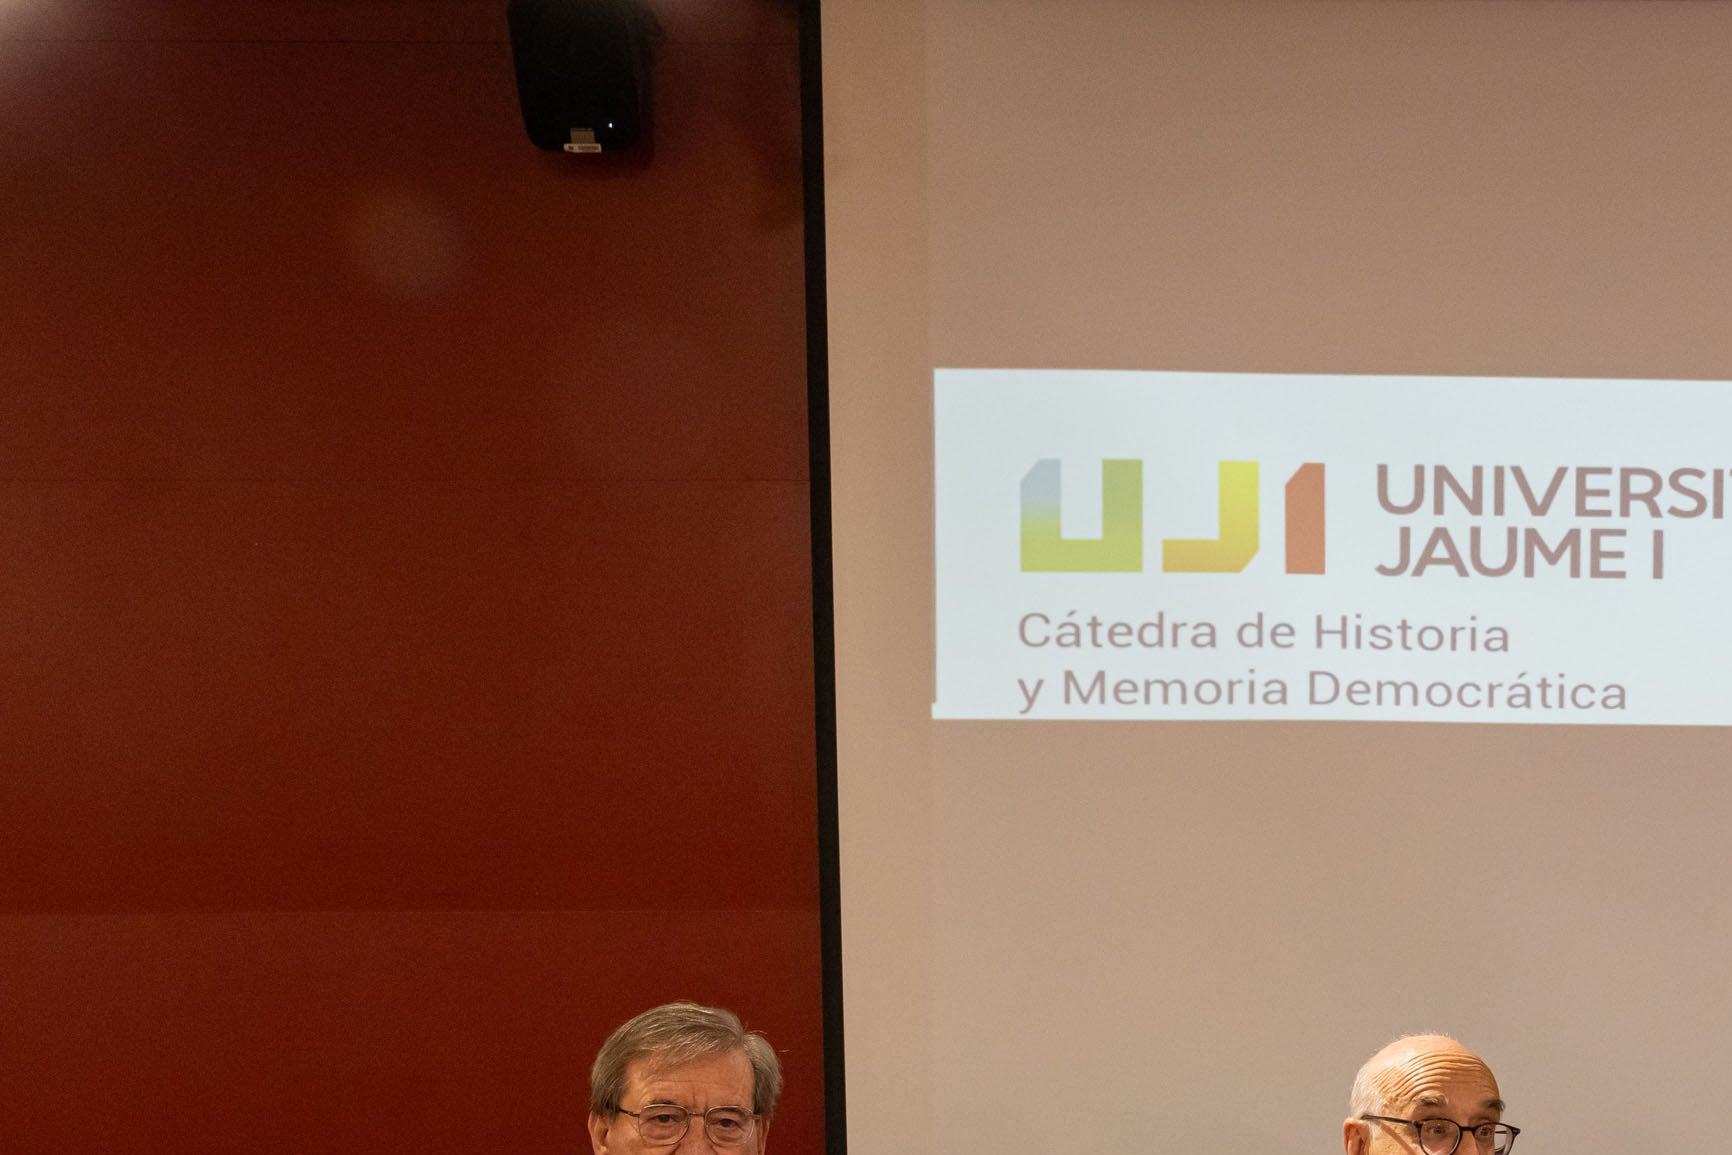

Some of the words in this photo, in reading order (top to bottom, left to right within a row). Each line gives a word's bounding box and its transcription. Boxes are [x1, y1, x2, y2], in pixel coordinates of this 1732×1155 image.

[1375, 526, 1628, 580] JAUME
[1652, 529, 1665, 580] I
[1018, 611, 1218, 650] Cátedra
[1236, 612, 1297, 650] de
[1314, 614, 1510, 653] Historia
[1017, 677, 1045, 716] y
[1063, 670, 1289, 707] Memoria
[1308, 671, 1628, 711] Democrática
